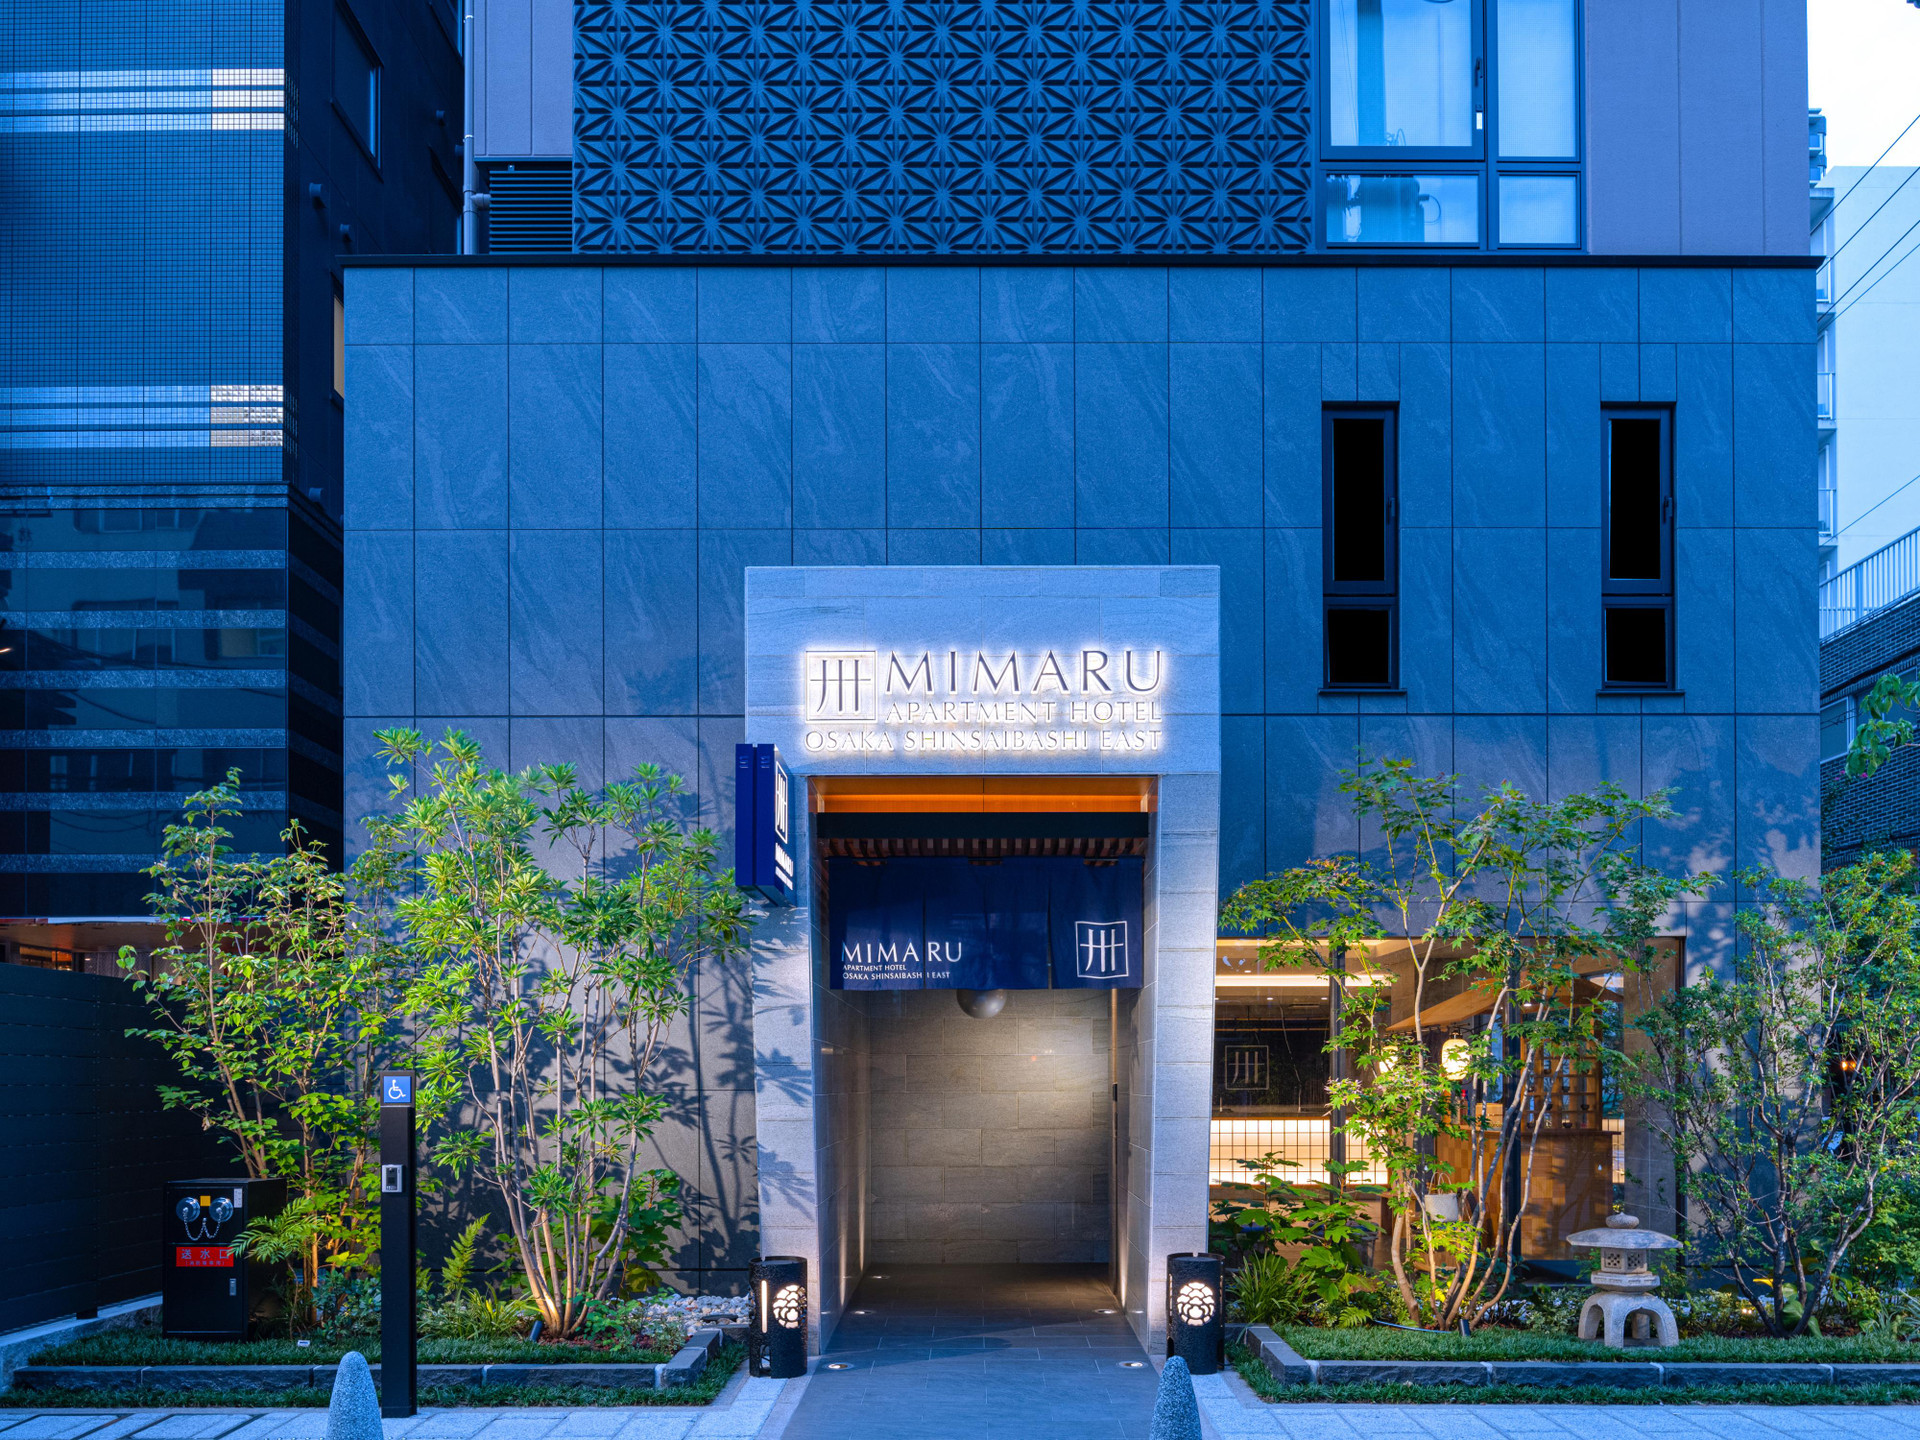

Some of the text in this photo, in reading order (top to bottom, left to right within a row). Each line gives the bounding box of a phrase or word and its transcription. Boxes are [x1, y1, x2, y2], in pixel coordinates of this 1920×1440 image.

[885, 650, 1162, 694] MIMARU
[886, 701, 1162, 723] APARTMENT HOTEL
[804, 730, 1162, 750] OSAKA SHINSAIBASHI EAST
[841, 940, 962, 963] MIMARU
[842, 972, 869, 980] OSAKA
[931, 971, 951, 979] EAST
[843, 964, 907, 972] APARTMENT HOTEL
